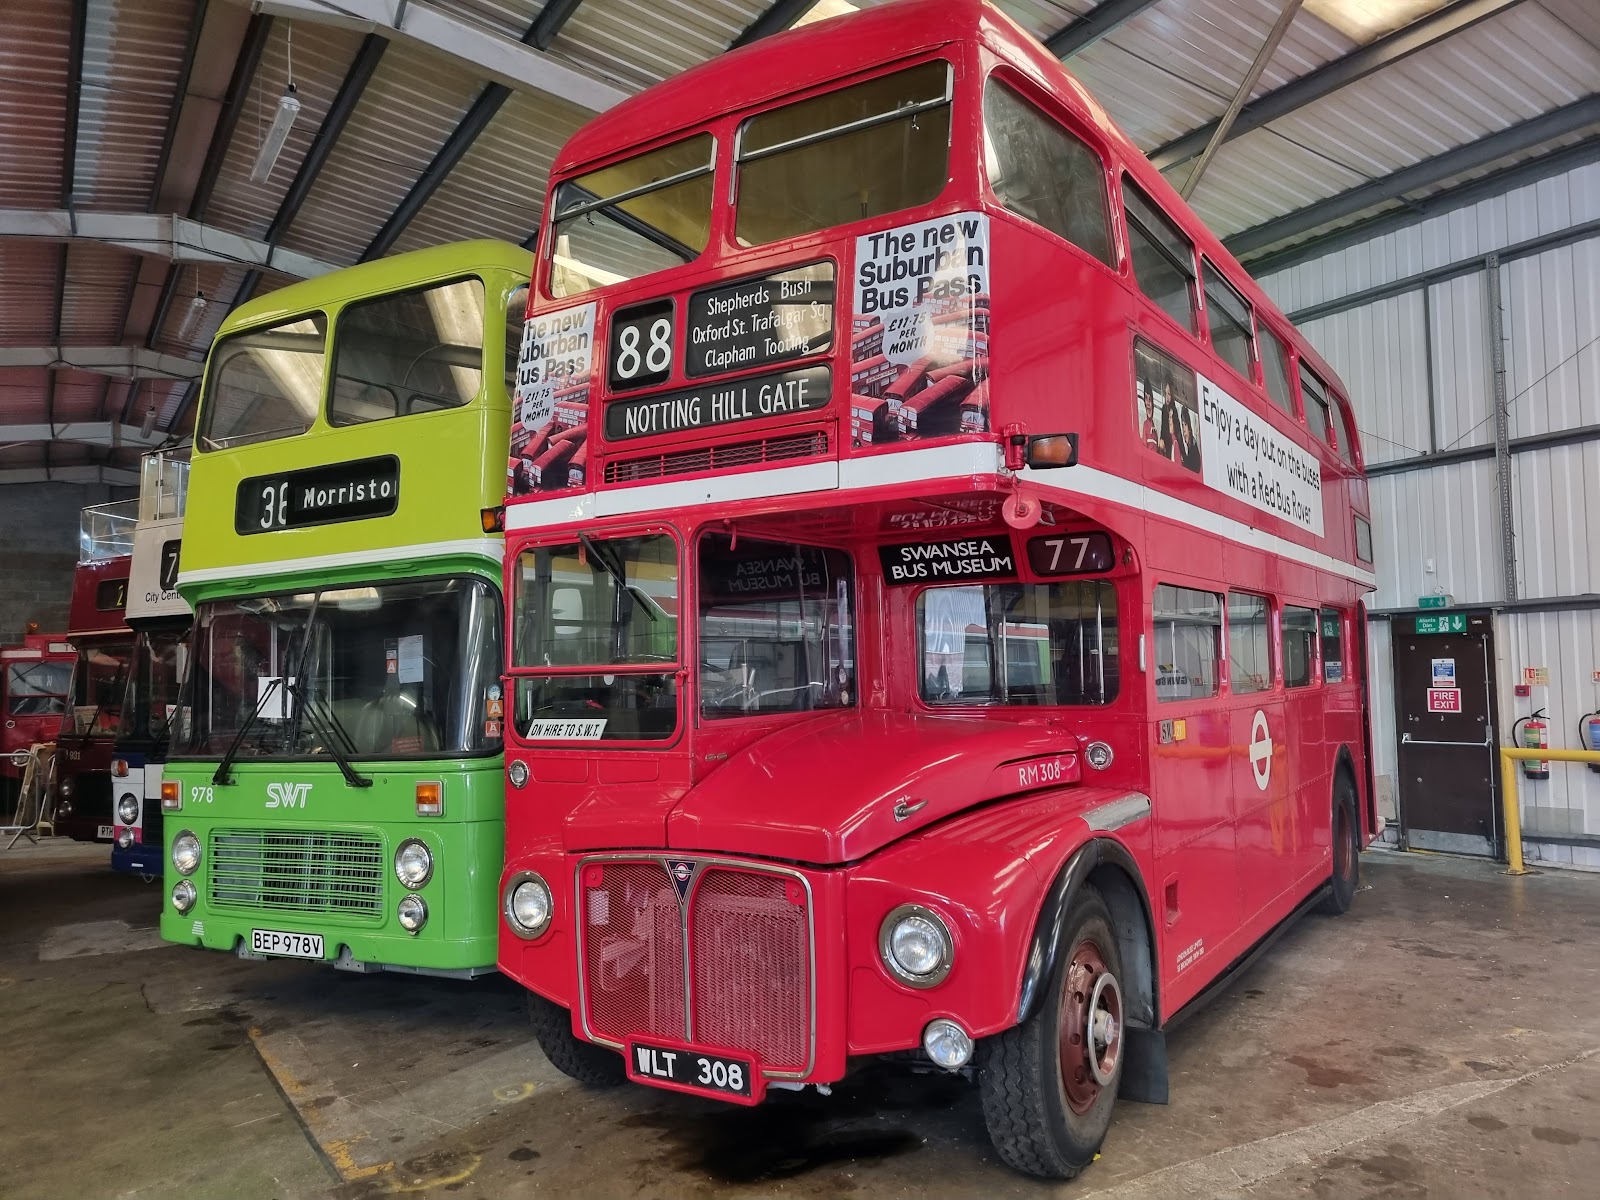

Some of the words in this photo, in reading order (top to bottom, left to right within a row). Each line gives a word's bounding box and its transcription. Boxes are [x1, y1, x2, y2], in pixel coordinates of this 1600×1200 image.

[868, 231, 915, 260] The
[923, 219, 979, 248] new
[859, 245, 984, 287] Suburban
[707, 286, 769, 316] Shepherds
[781, 277, 811, 299] Bush
[861, 287, 908, 314] Bus
[917, 273, 981, 304] Pass
[551, 310, 587, 334] new
[692, 320, 730, 345] Oxford
[732, 319, 748, 335] St.
[751, 307, 806, 333] Trafalgar
[899, 327, 916, 339] PER
[519, 332, 588, 364] uburban
[616, 318, 672, 379] 88
[705, 344, 756, 369] Clapham
[765, 334, 809, 357] Tooting
[888, 335, 928, 355] MONTH
[519, 364, 540, 386] us
[544, 355, 585, 381] Pass
[524, 408, 550, 423] MONTH
[532, 399, 543, 410] PER
[625, 397, 701, 434] NOTTING
[712, 388, 752, 422] HILL
[759, 378, 809, 414] GATE
[1202, 385, 1232, 445] Enjoy
[1235, 418, 1241, 442] a
[1243, 416, 1260, 462] day
[1277, 444, 1287, 468] on
[1288, 447, 1301, 479] the
[1302, 455, 1320, 491] buses
[303, 478, 397, 509] Morristo
[1226, 461, 1249, 495] with
[1251, 477, 1257, 499] a
[1258, 471, 1276, 508] Red
[1277, 482, 1291, 513] Bus
[1292, 490, 1311, 525] Rover
[900, 540, 995, 562] SWANSEA
[1045, 537, 1090, 571] 77
[891, 561, 927, 580] BUS
[933, 556, 1012, 576] MUSEUM
[145, 592, 160, 604] City
[161, 589, 183, 601] Cent
[1433, 692, 1455, 701] FIRE
[1434, 701, 1455, 709] EXIT
[531, 724, 544, 736] ON
[543, 724, 564, 736] HIRE
[564, 724, 576, 736] TO
[576, 724, 600, 737] S.W.T.
[192, 787, 213, 803] 978
[265, 782, 313, 808] SWT
[636, 1047, 677, 1078] WLT
[697, 1059, 744, 1091] 308
